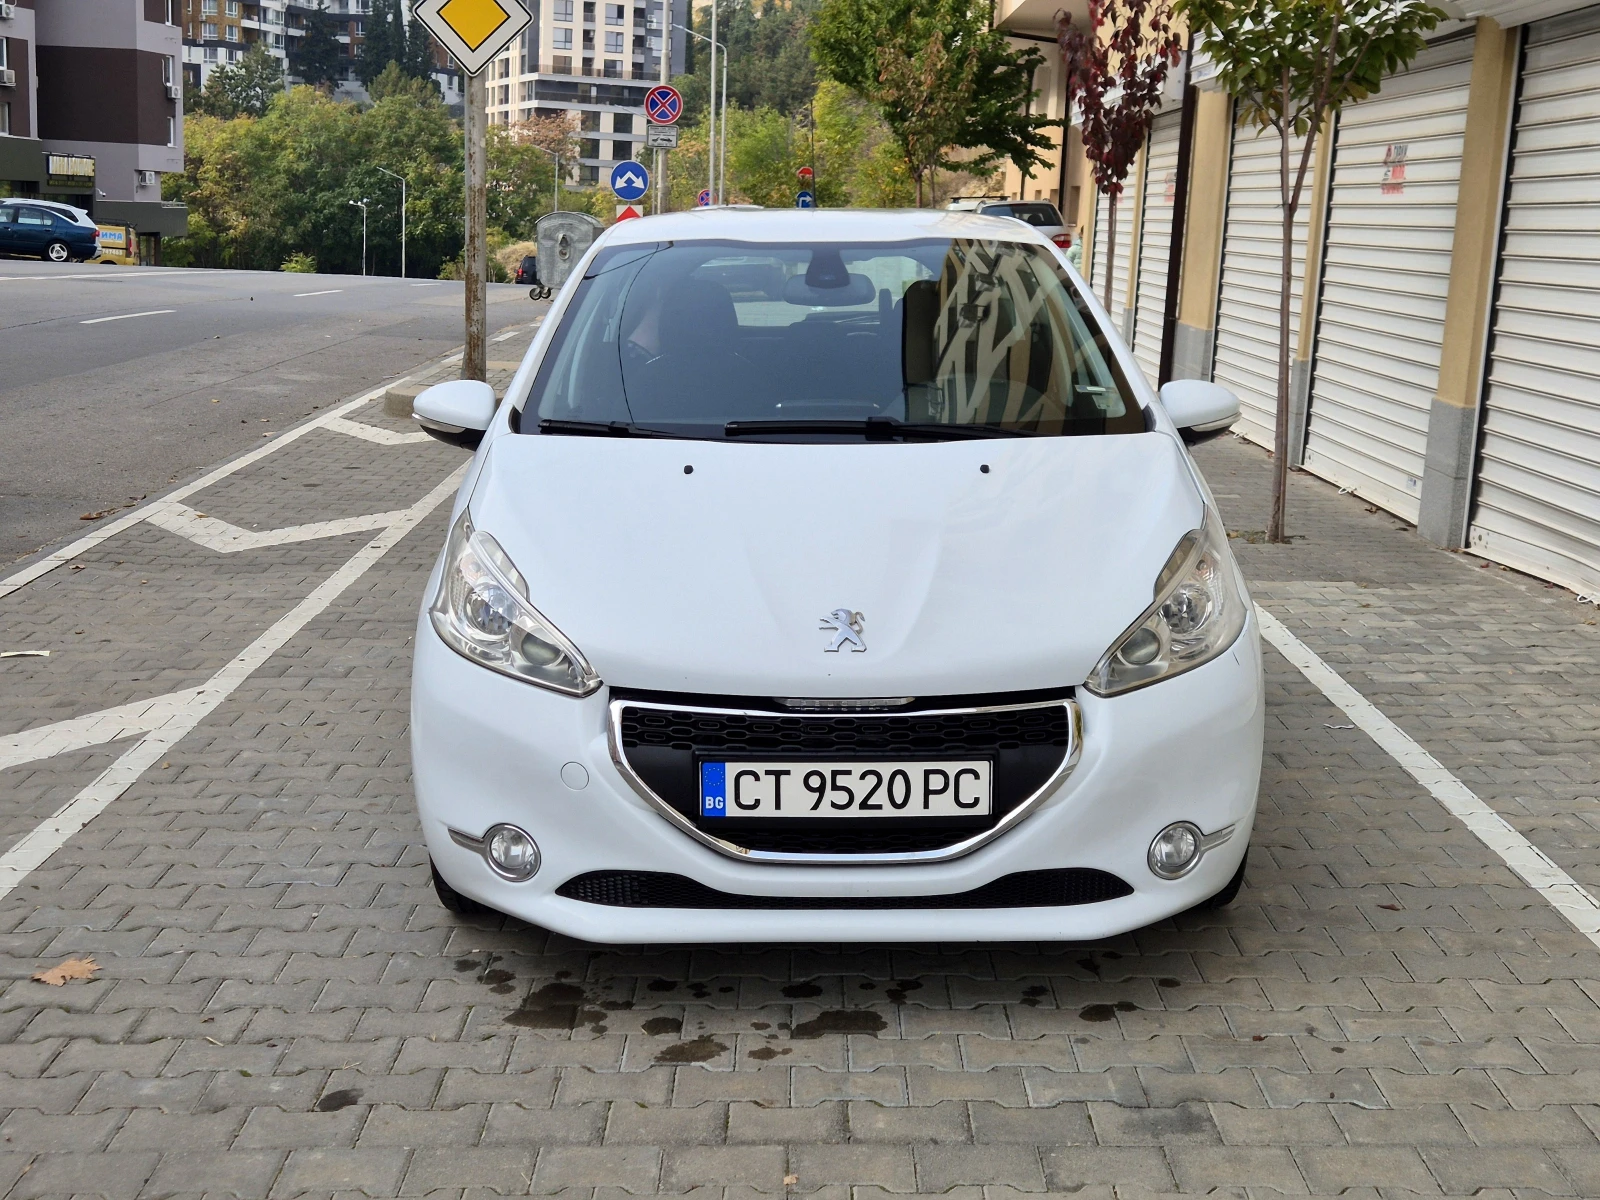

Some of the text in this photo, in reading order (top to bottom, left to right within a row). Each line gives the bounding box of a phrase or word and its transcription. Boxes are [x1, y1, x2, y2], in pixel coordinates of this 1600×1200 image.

[705, 797, 724, 809] BG
[733, 768, 981, 811] CT 9520 PC
